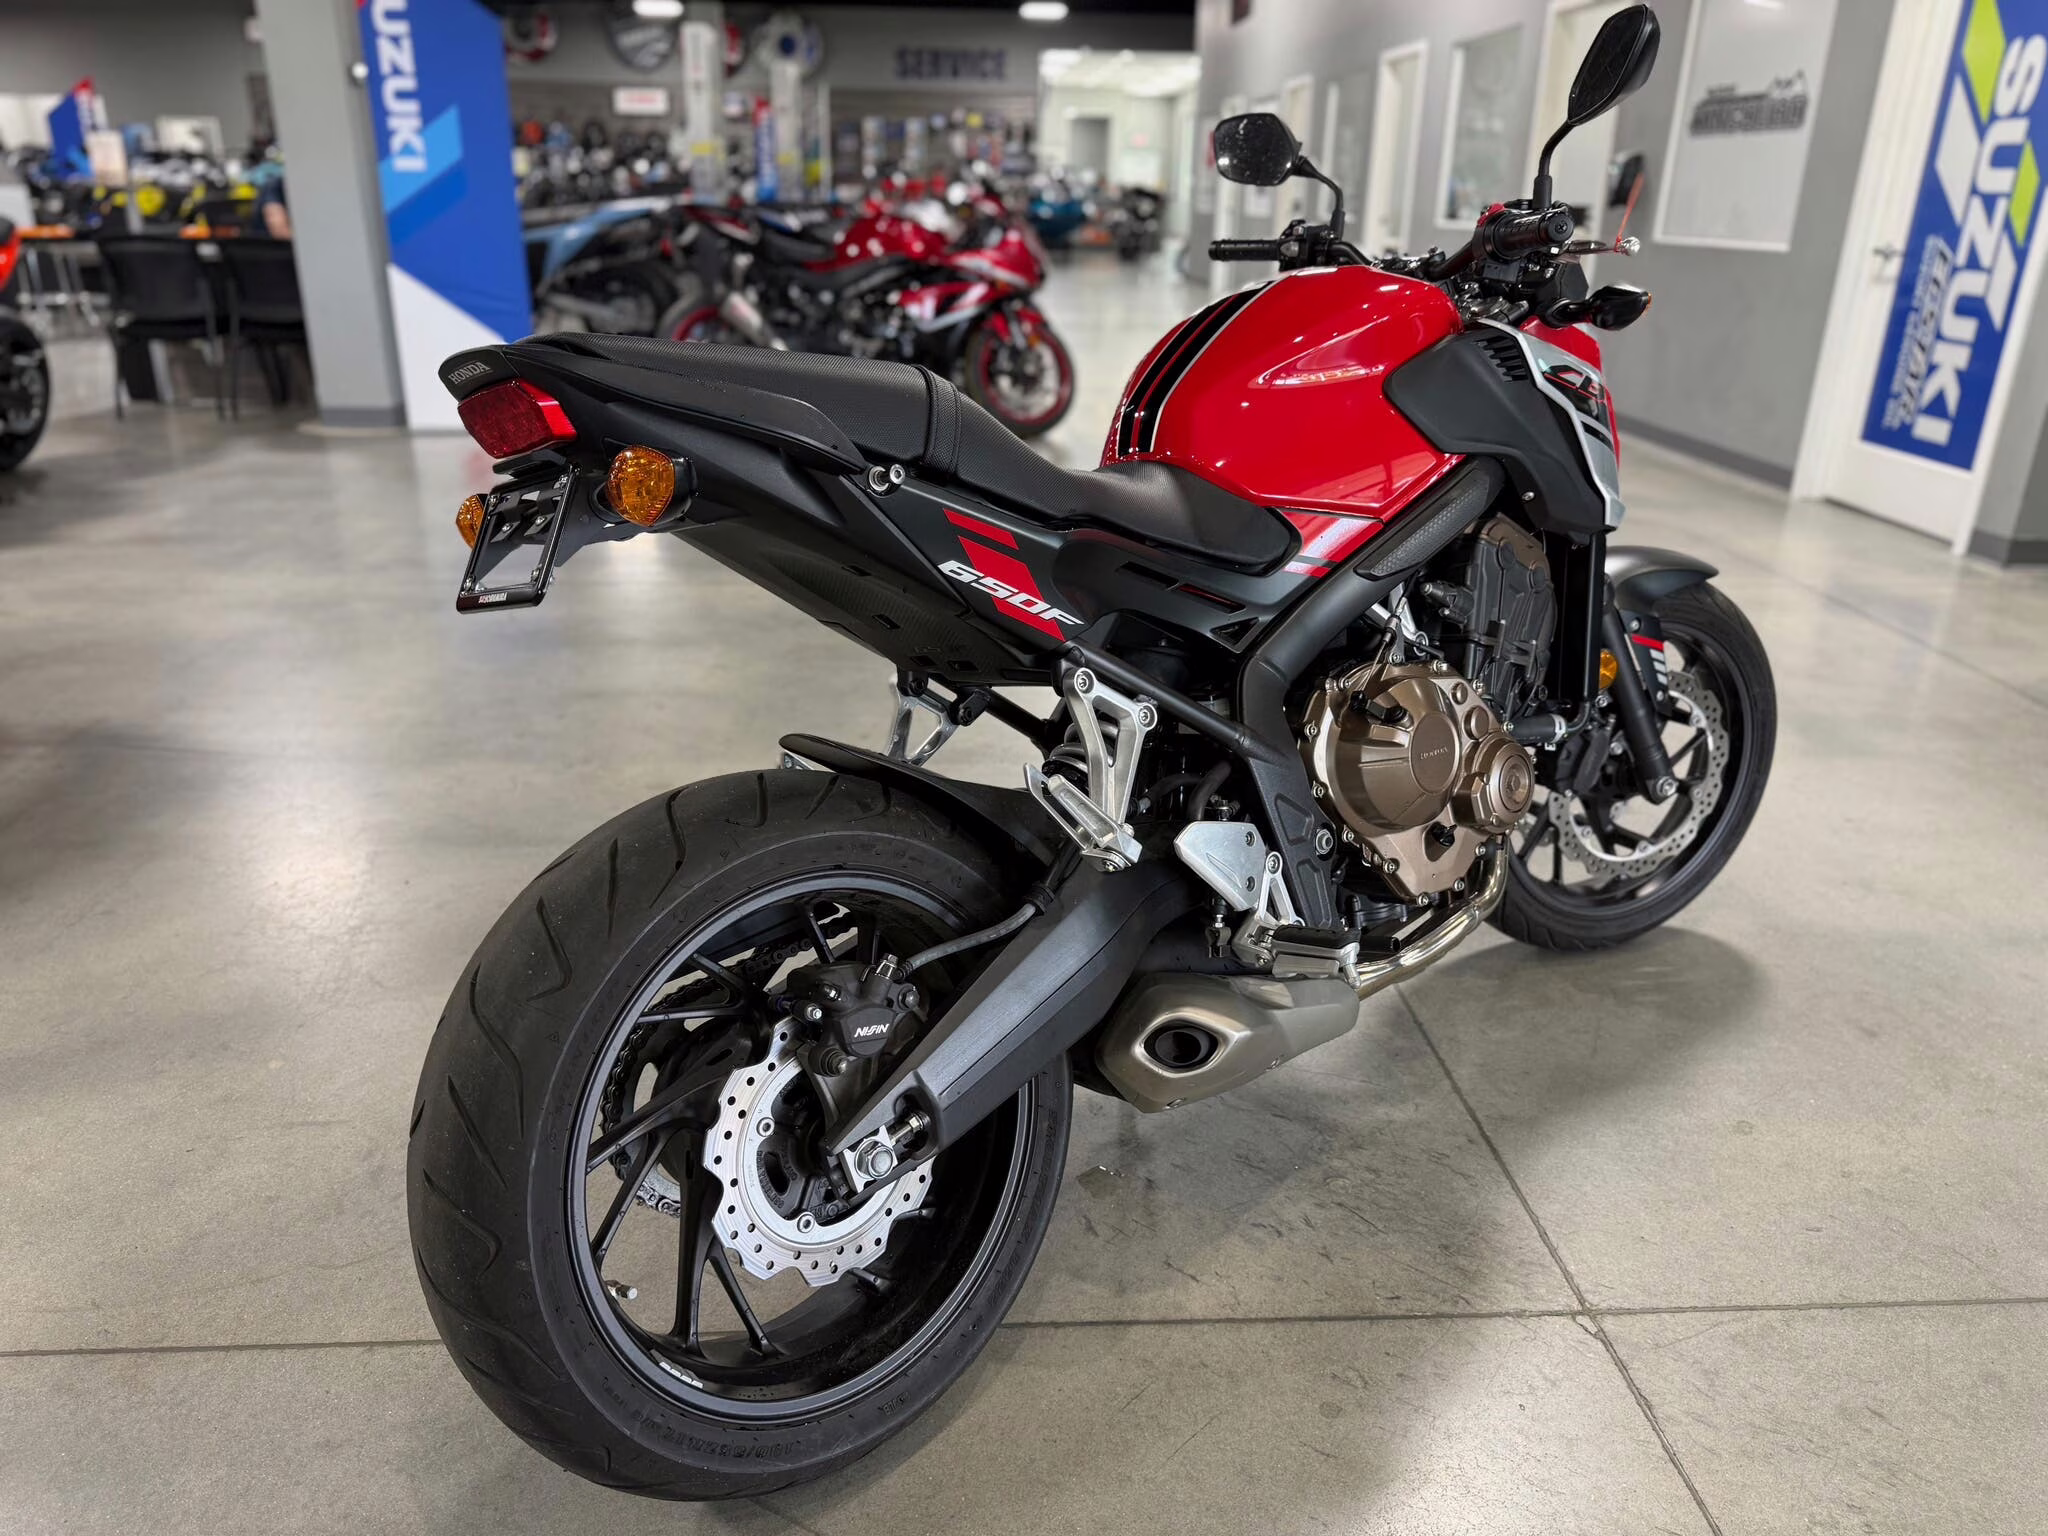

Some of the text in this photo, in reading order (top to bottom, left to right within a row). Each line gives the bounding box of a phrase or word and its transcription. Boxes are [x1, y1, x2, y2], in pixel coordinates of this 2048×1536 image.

[1911, 35, 2046, 446] SUZUKI
[448, 361, 491, 384] HONDA
[937, 560, 1085, 625] 650F
